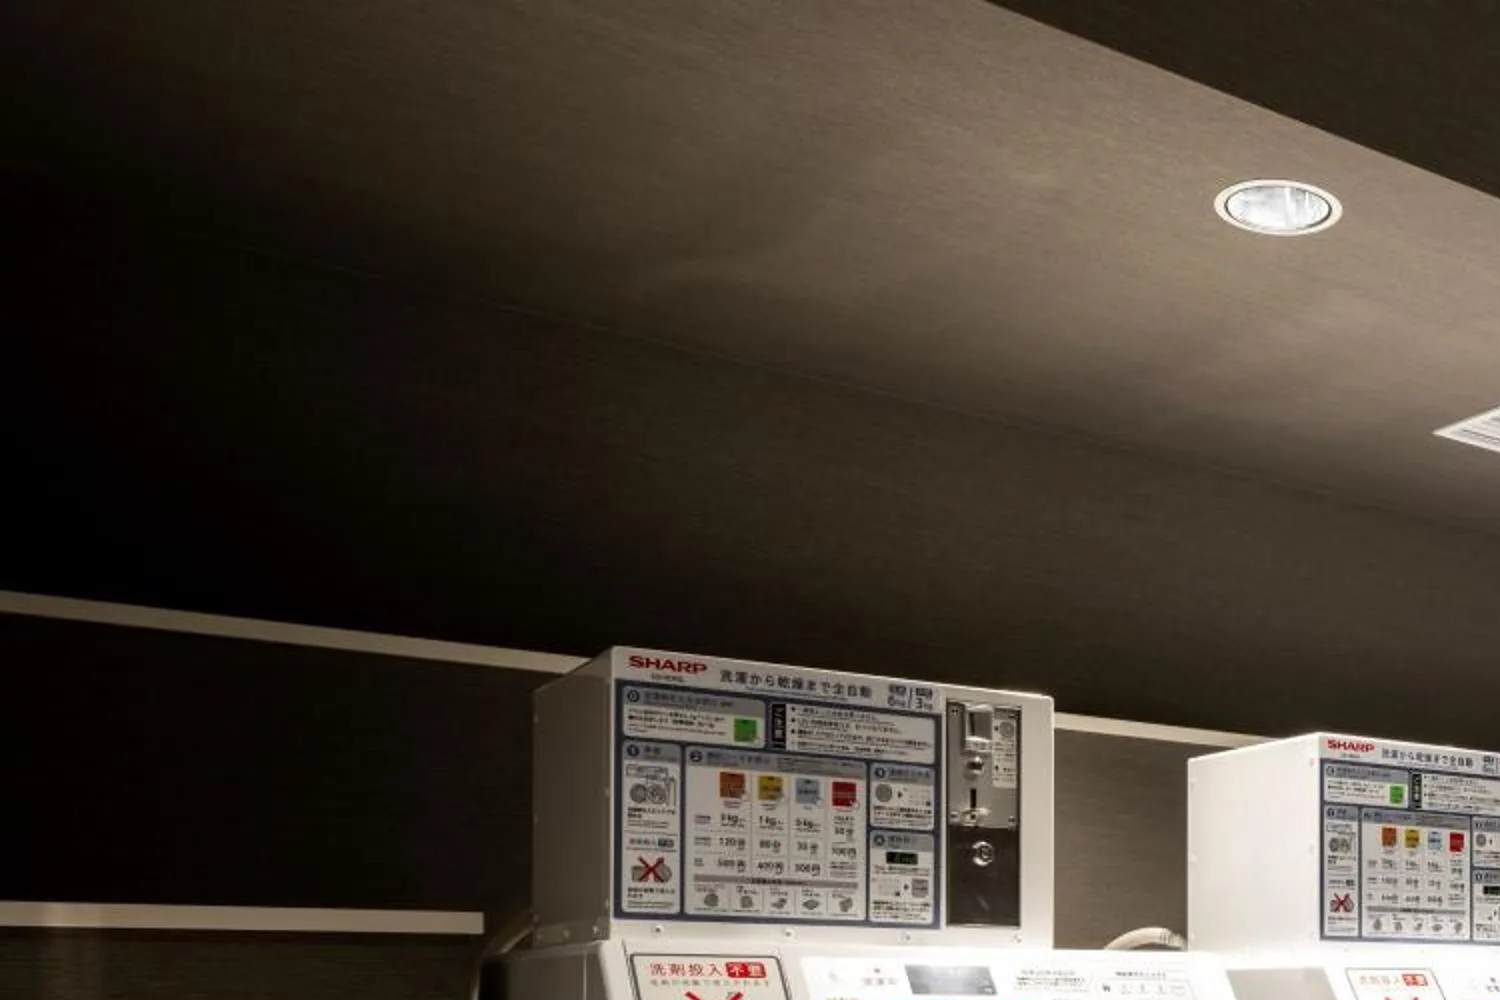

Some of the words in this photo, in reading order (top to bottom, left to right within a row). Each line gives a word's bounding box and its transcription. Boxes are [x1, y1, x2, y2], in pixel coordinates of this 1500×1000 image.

[629, 655, 708, 673] SHARP
[719, 669, 872, 698] 洗濯から乾燥まで全自動
[1327, 740, 1376, 753] SHARP
[650, 962, 722, 977] 洗剤投入
